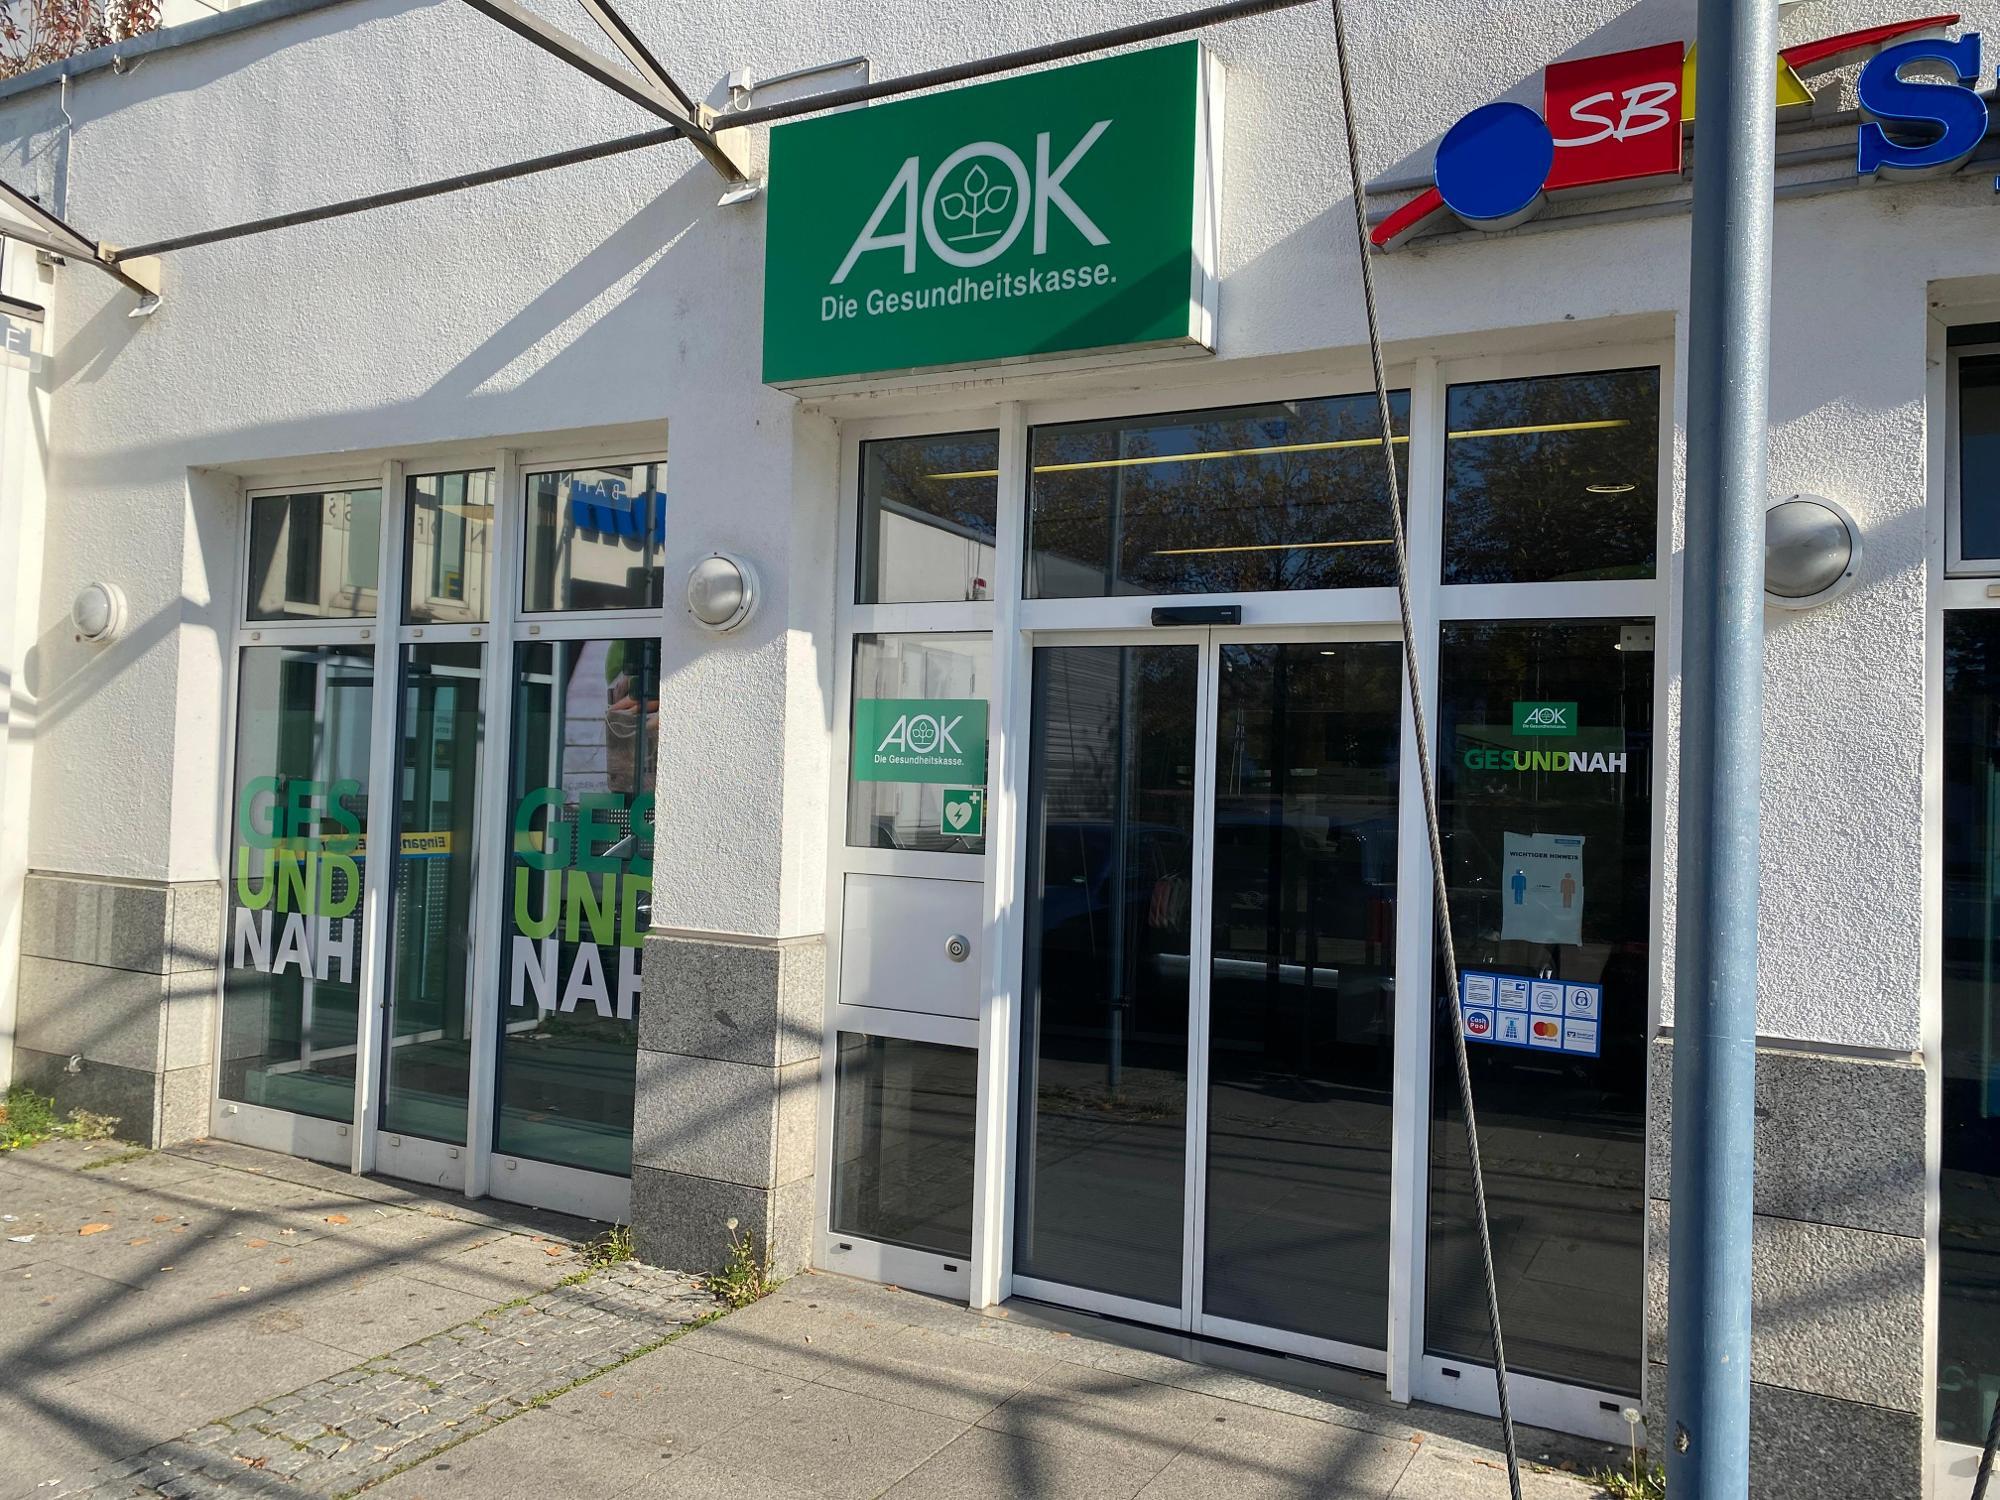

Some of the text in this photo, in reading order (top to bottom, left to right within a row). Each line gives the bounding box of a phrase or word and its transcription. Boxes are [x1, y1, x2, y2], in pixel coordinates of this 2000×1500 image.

[1552, 81, 1677, 148] SB
[829, 118, 1114, 285] AOK
[820, 262, 1117, 322] Die Gesundheitskasse.
[876, 714, 964, 754] AOK
[1523, 707, 1567, 725] AOK
[873, 754, 965, 766] Die Gesundheitskasse.
[1463, 749, 1627, 773] GESUNDNAH
[239, 775, 361, 855] GES
[1509, 850, 1548, 859] WICHTIGER
[237, 845, 360, 919] UND
[233, 906, 355, 984] NAH
[1470, 1016, 1487, 1025] Cash
